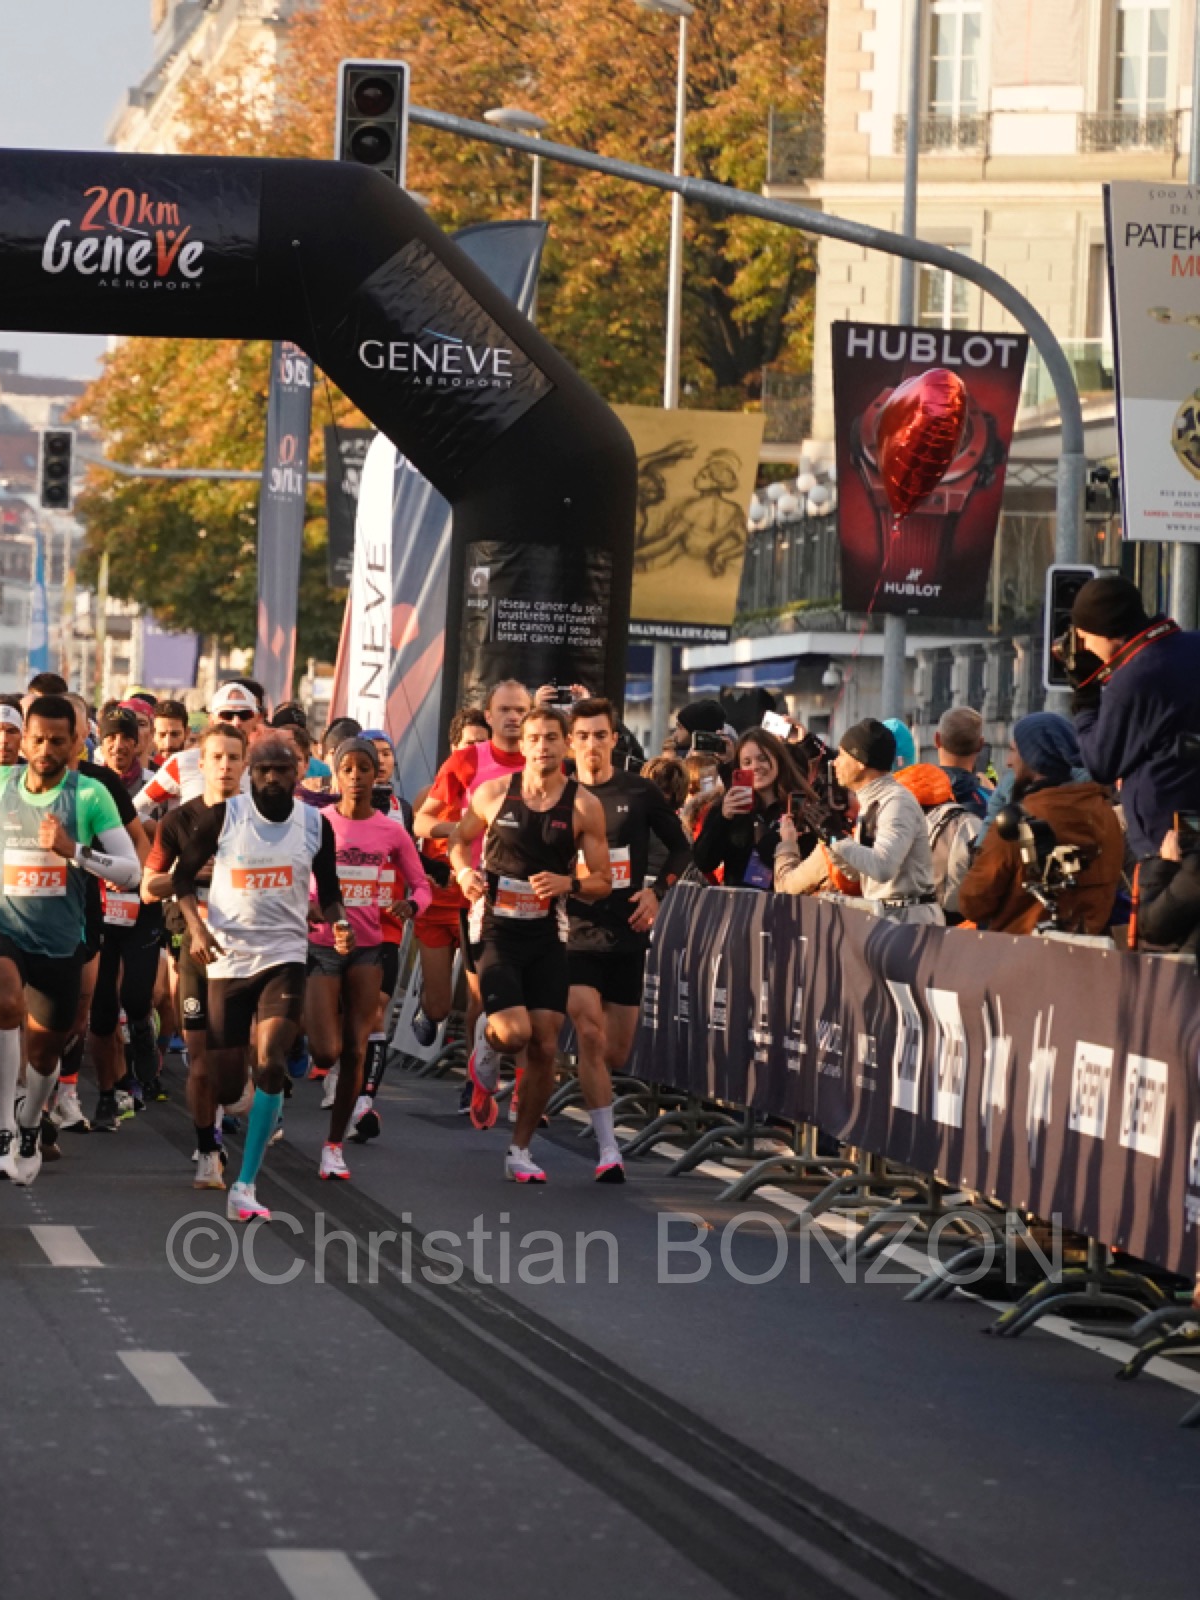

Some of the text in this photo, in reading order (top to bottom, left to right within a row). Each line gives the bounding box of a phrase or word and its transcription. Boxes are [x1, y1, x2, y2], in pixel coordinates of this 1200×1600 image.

[846, 327, 1018, 369] HUBLOT
[884, 582, 942, 597] HUBLOT
[17, 872, 62, 889] 2975
[245, 871, 288, 889] 2774
[340, 883, 373, 899] 786
